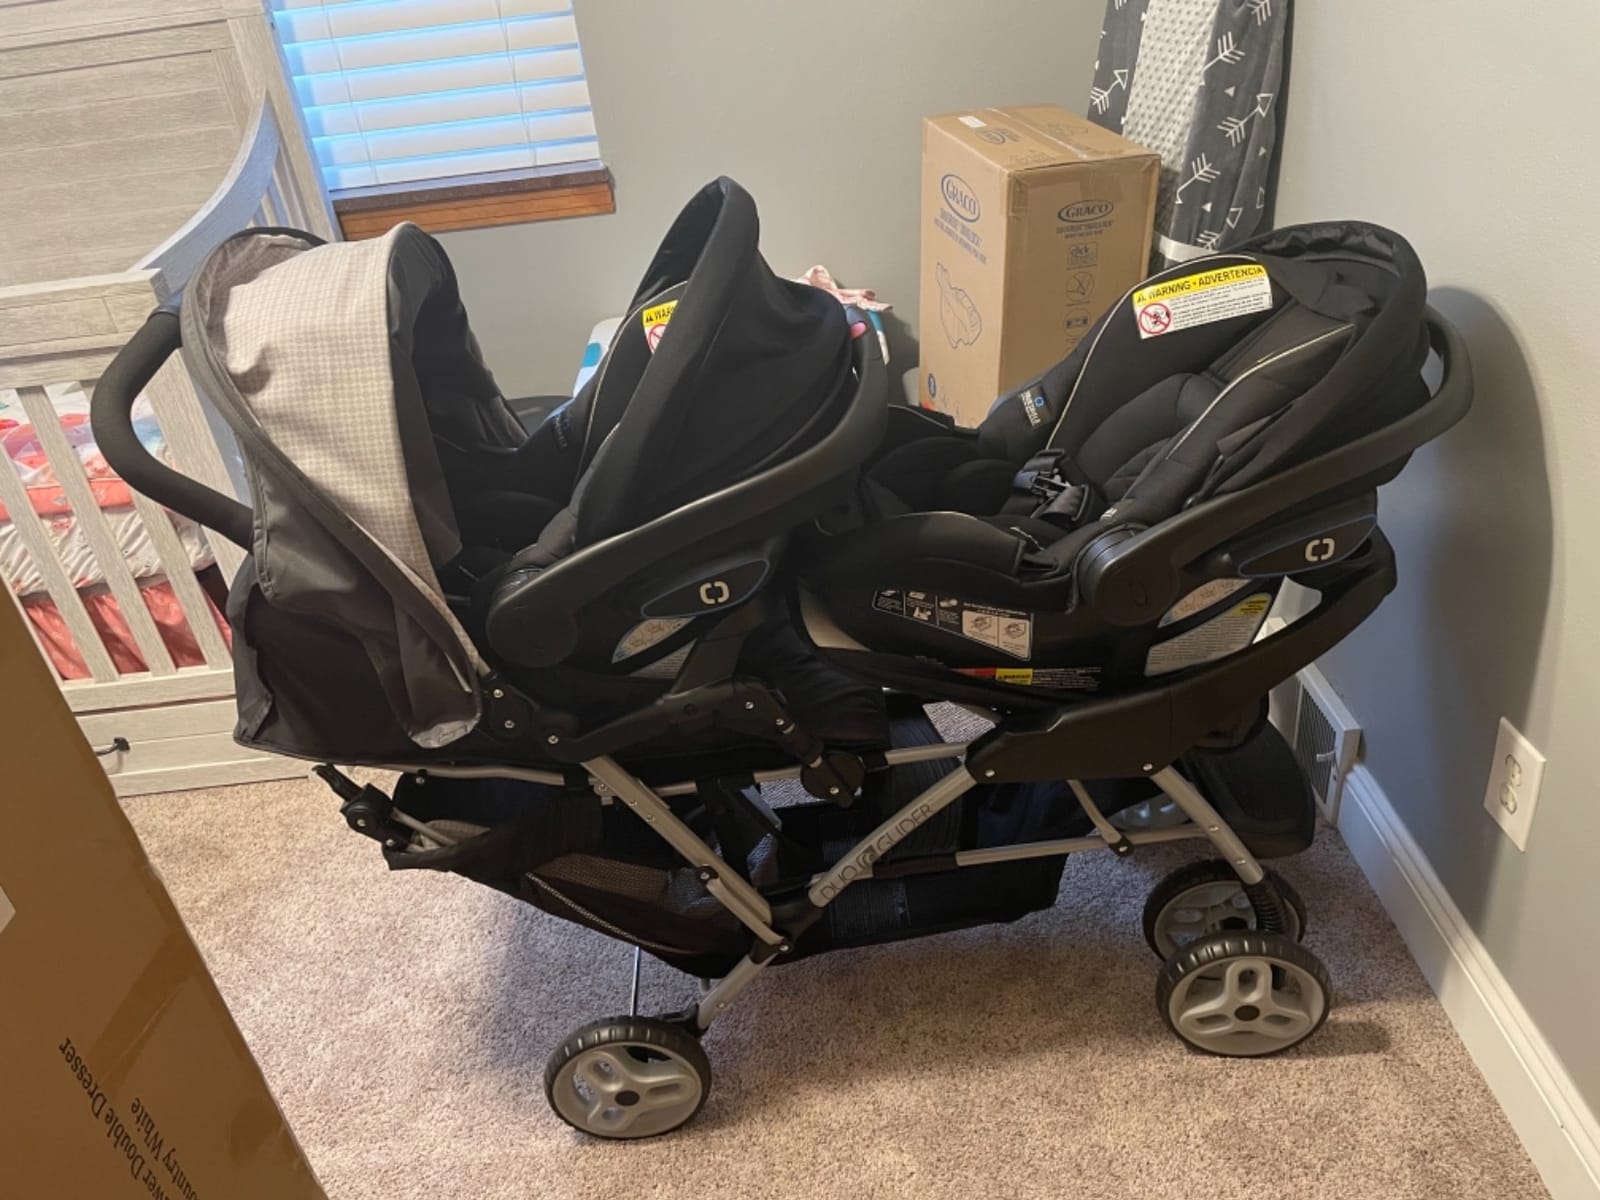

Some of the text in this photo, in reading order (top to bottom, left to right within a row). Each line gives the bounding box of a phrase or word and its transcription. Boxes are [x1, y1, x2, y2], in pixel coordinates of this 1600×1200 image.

[946, 179, 976, 215] GRACO
[1066, 204, 1108, 217] GRACO
[1149, 269, 1264, 300] WARNING ADVERTENCIA
[876, 803, 934, 852] GLIDER
[58, 1037, 108, 1119] Dresser
[103, 1107, 145, 1180] Double
[131, 1097, 164, 1161] White
